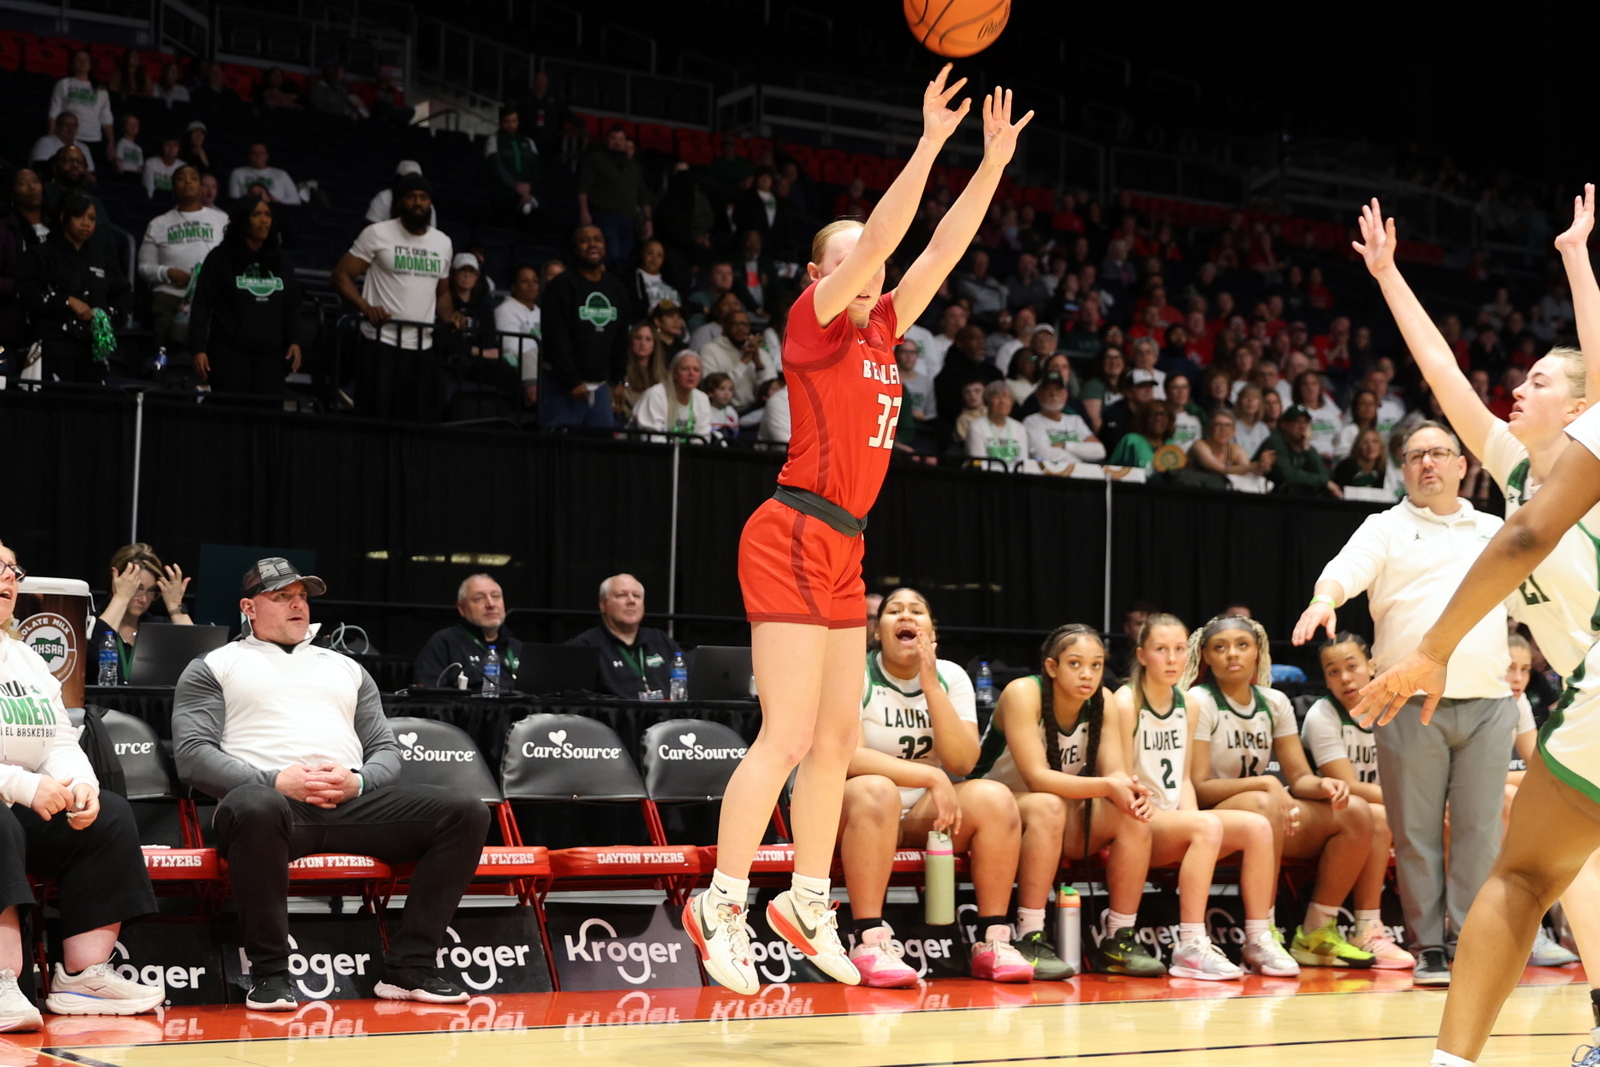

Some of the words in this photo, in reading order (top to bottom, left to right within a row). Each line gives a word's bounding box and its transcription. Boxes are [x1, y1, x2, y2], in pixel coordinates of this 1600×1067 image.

[167, 226, 214, 243] MOMENT
[394, 246, 411, 255] IT'S
[412, 247, 429, 256] OUR
[394, 255, 441, 273] MOMENT
[868, 393, 902, 449] 32
[52, 618, 71, 635] MILK
[896, 735, 934, 760] 32
[1226, 729, 1269, 750] LAUREL
[521, 741, 621, 760] CareSource
[658, 744, 747, 761] CareSource
[1160, 758, 1176, 789] 2
[151, 855, 203, 867] FLYERS
[325, 856, 375, 867] FLYERS
[491, 853, 536, 865] FLYERS
[597, 853, 641, 864] DAYTON
[643, 852, 685, 864] FLYERS
[435, 926, 529, 990] roger
[564, 917, 681, 985] Kroger
